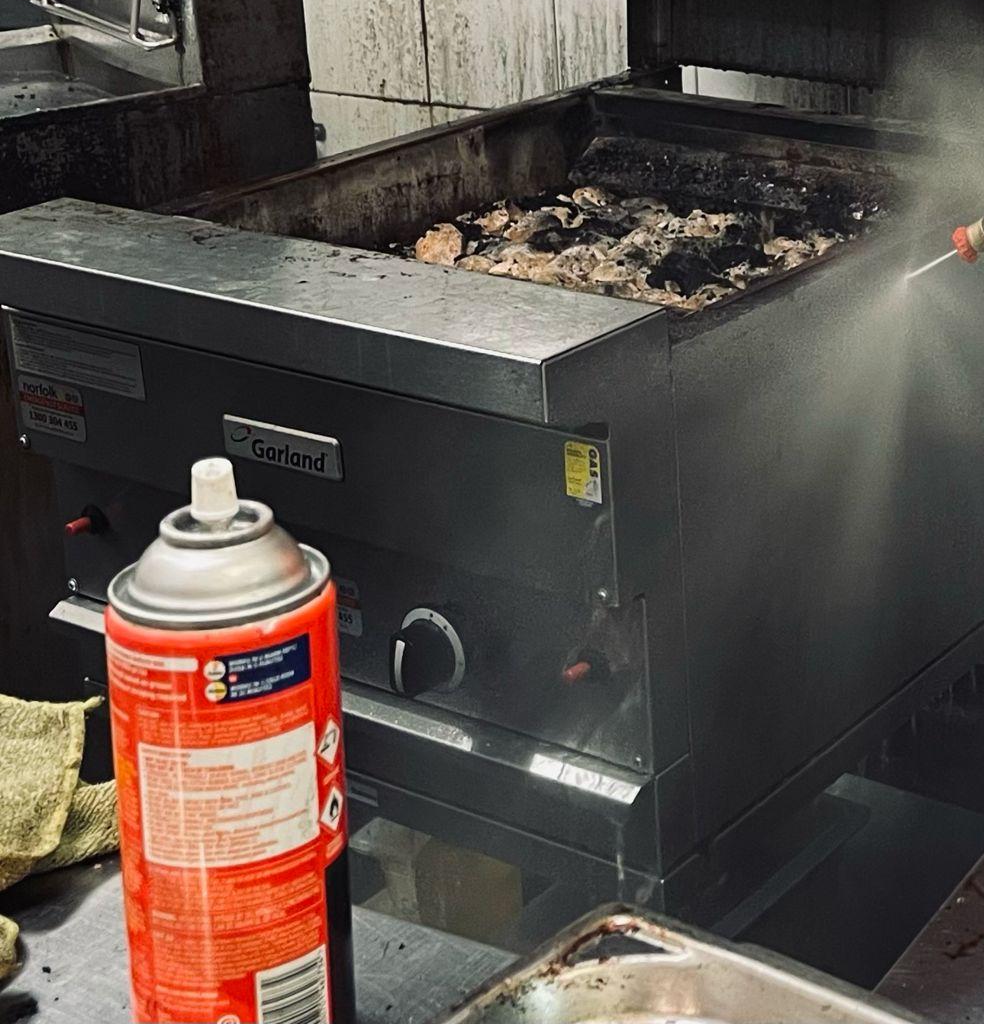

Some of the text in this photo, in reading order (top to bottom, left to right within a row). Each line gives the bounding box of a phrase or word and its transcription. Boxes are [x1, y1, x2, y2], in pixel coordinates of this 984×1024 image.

[23, 382, 58, 399] norfolk
[251, 438, 326, 473] Garland
[588, 448, 599, 478] GAS
